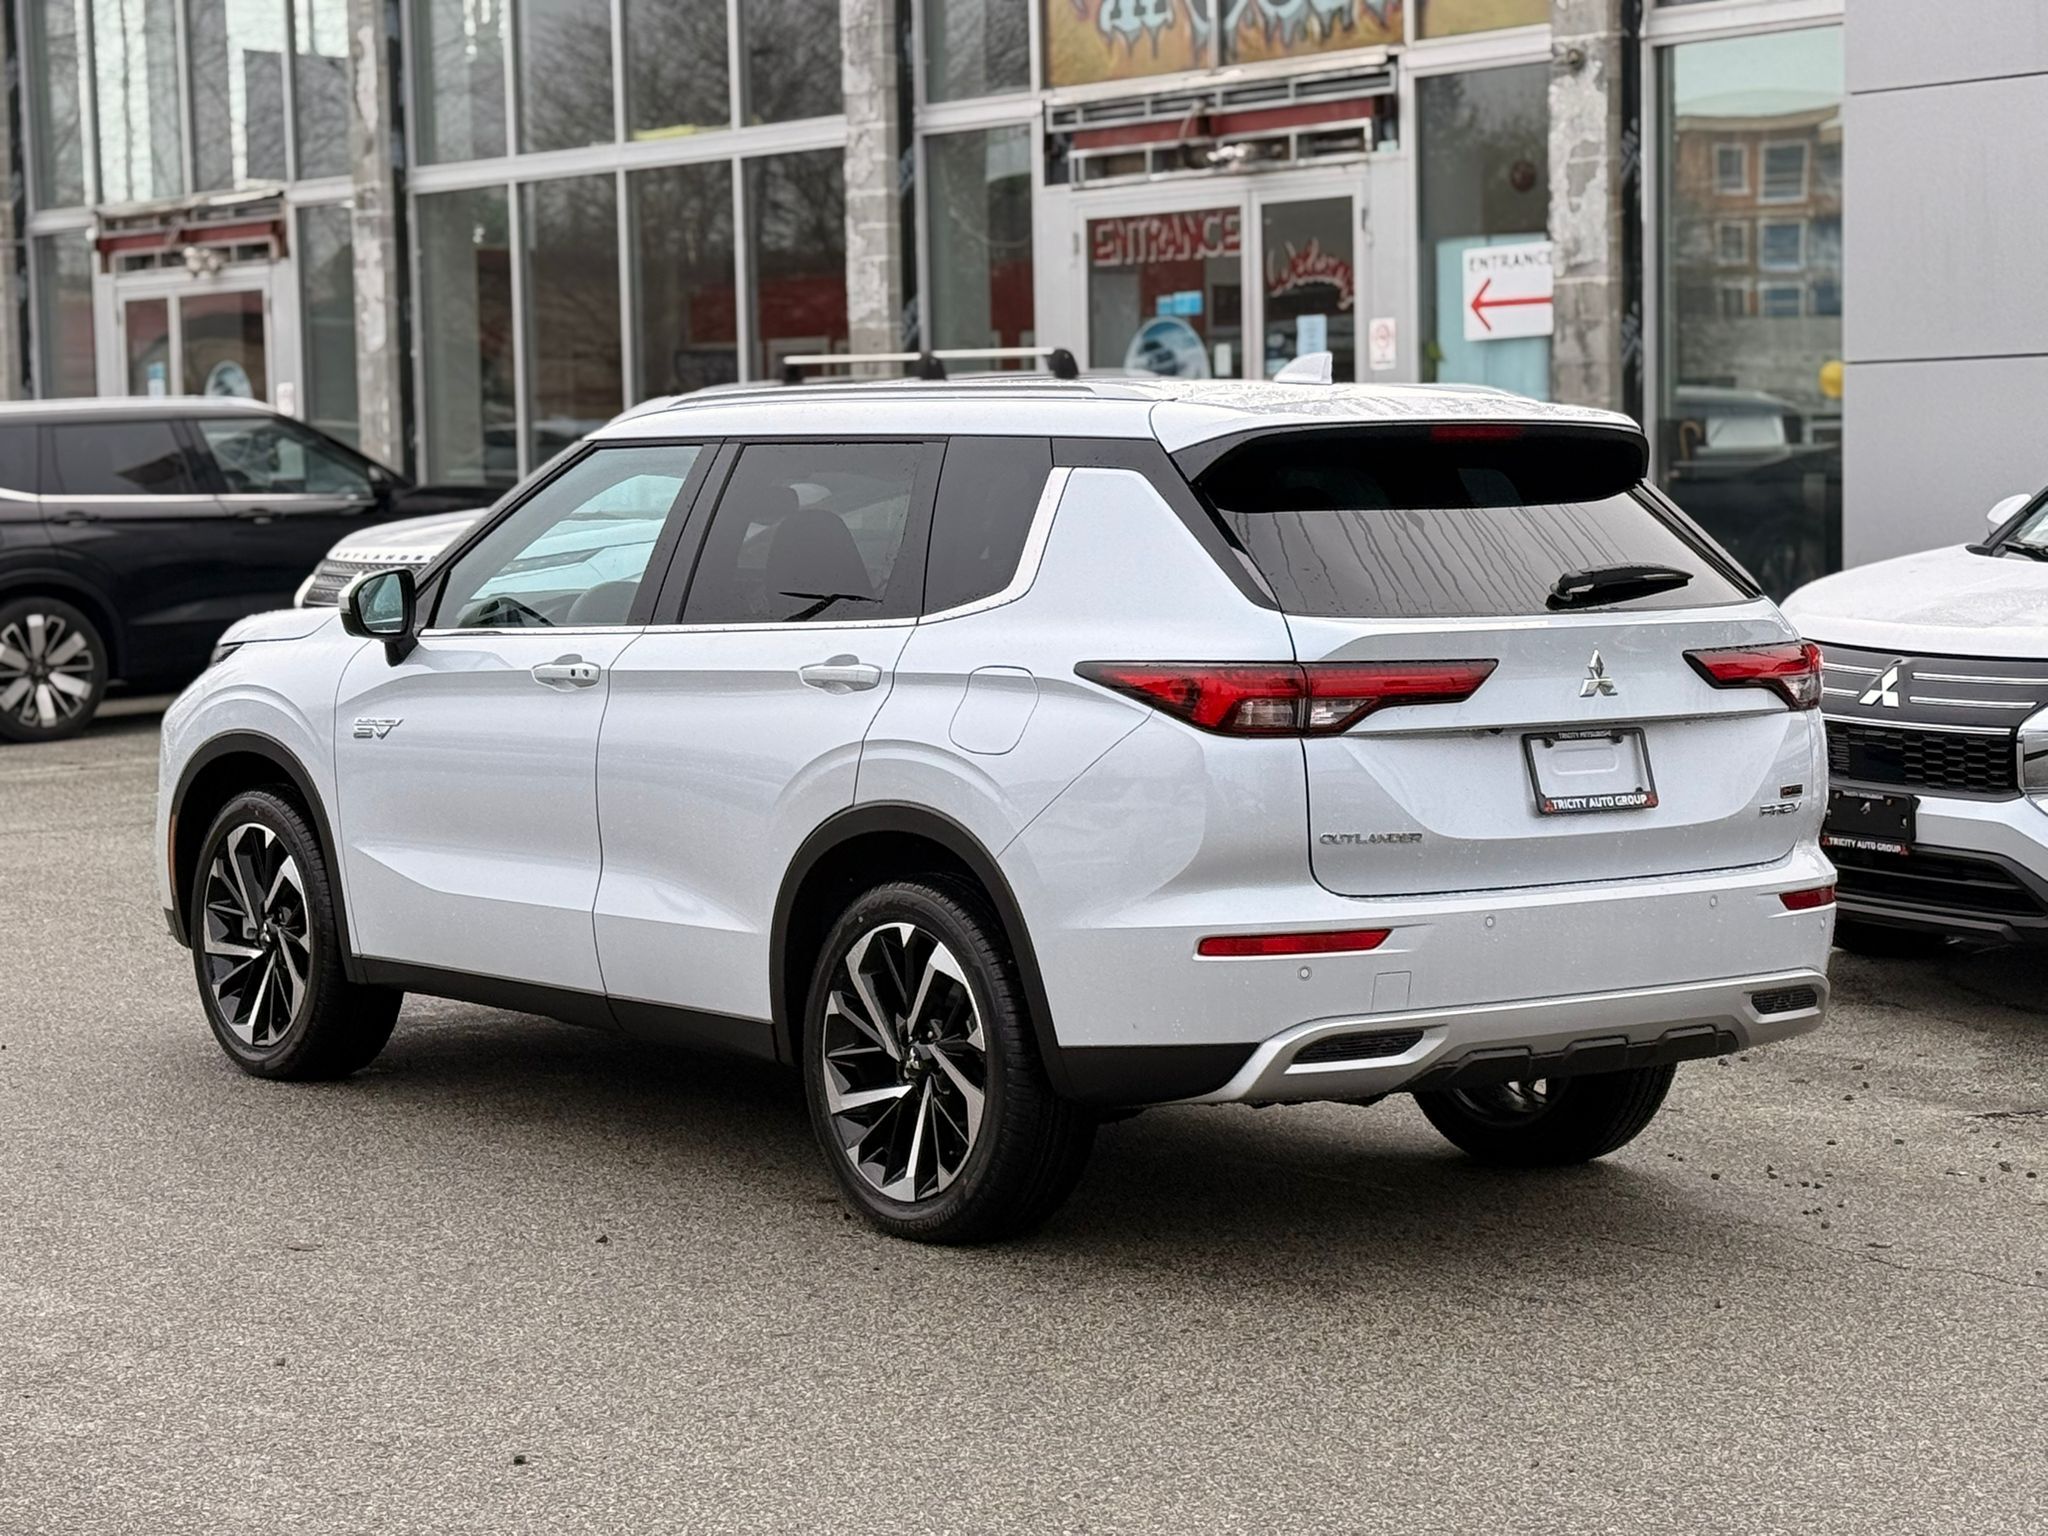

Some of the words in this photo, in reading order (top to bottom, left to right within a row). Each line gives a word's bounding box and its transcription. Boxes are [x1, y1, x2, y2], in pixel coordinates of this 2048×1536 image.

[1093, 211, 1241, 266] ENTRANCE
[1551, 797, 1587, 810] TRICITY
[1589, 796, 1614, 808] AUTO
[1615, 794, 1647, 806] GROUP
[1319, 832, 1423, 845] OUTLANDER
[1828, 837, 1857, 849] TRICITY
[1857, 841, 1876, 850] AUTO
[1876, 842, 1902, 854] GROUP
